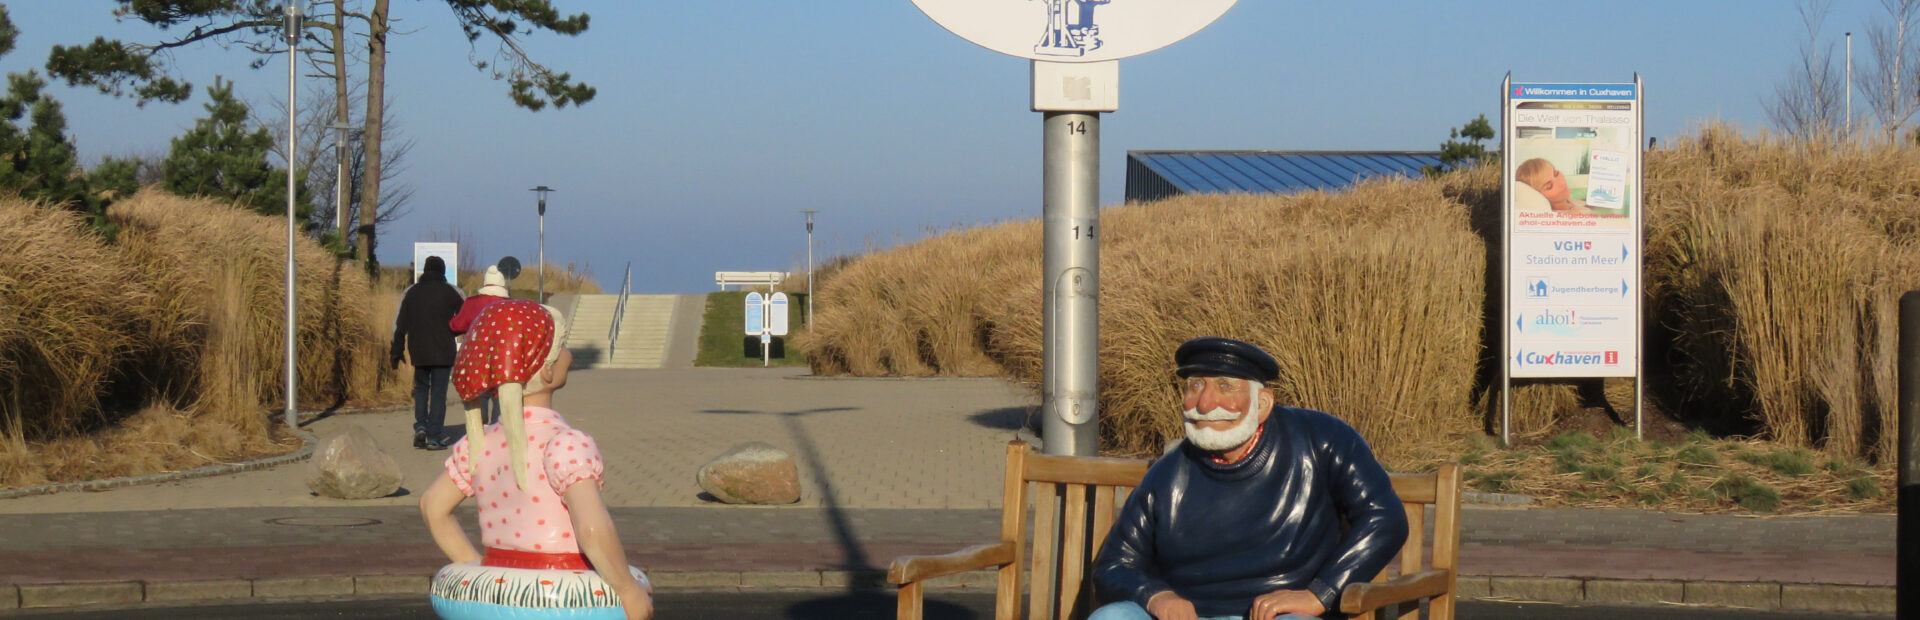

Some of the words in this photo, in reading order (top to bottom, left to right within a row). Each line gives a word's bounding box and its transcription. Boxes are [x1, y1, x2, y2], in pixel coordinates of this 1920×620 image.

[1525, 87, 1577, 96] Willkommen
[1579, 88, 1587, 96] in
[1589, 88, 1632, 96] Cuxhaven
[1517, 114, 1535, 123] Die
[1536, 114, 1560, 123] Welt
[1584, 115, 1630, 124] Thalasso
[1067, 121, 1086, 135] 14
[1519, 211, 1554, 219] Aktuelle
[1556, 212, 1599, 220] Angebote
[1553, 241, 1583, 251] VGH
[1526, 254, 1568, 265] Stadion
[1571, 257, 1587, 265] am
[1591, 255, 1618, 265] Meer
[1552, 286, 1618, 294] Jugendherberge
[1535, 308, 1575, 325] ahoi!
[1526, 351, 1601, 365] Cuxhaven
